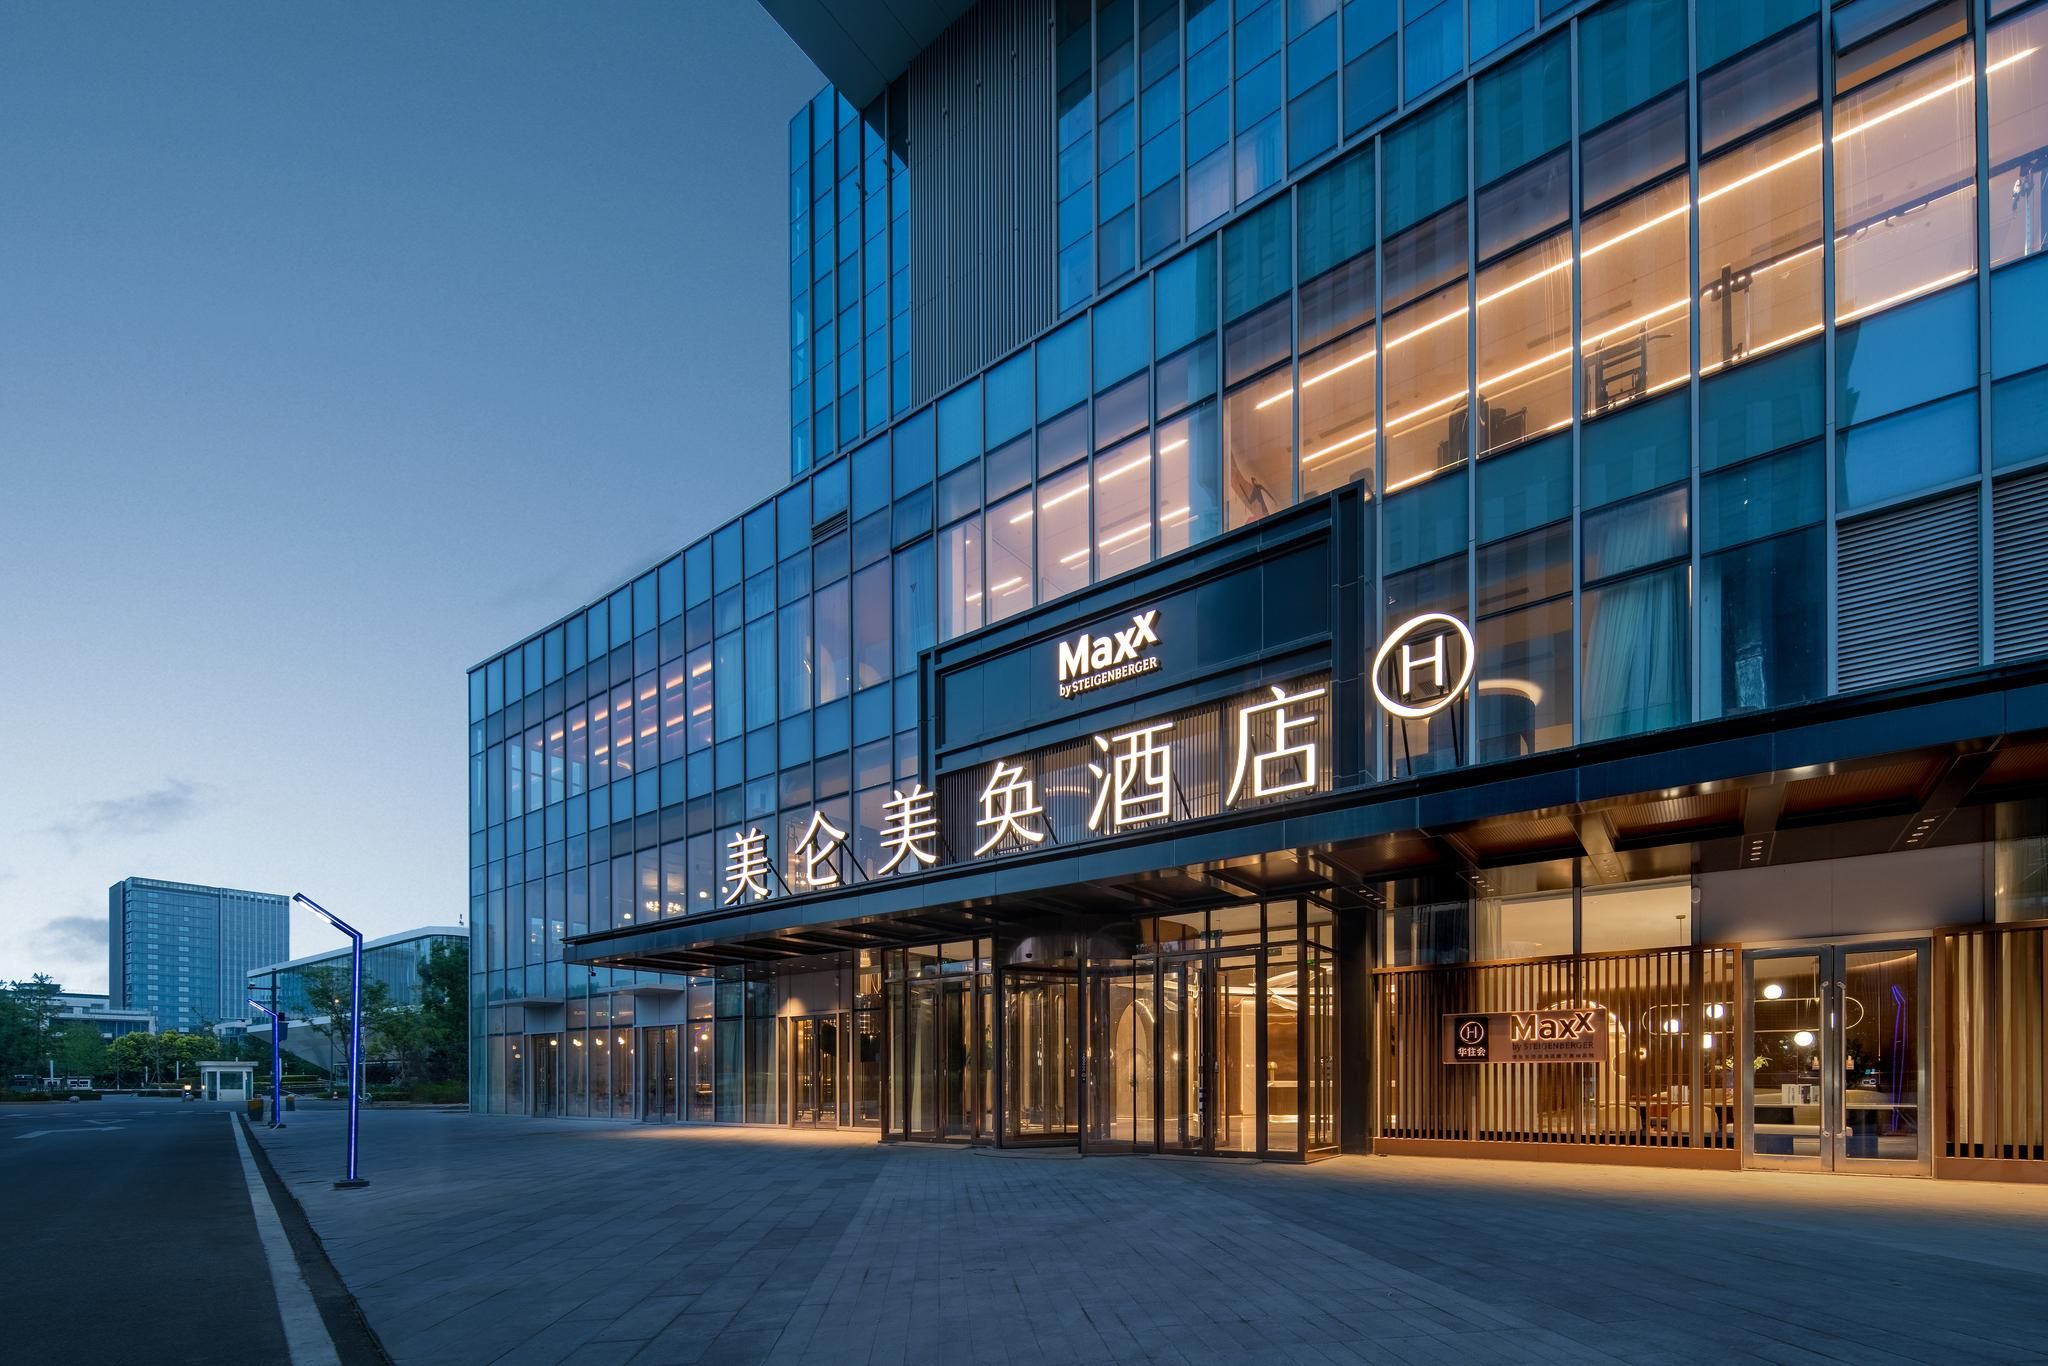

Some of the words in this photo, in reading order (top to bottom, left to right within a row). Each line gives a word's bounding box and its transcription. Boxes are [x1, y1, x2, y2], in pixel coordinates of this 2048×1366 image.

[1059, 610, 1158, 681] Maxx
[1060, 684, 1072, 698] by
[1072, 657, 1158, 693] STEIGENBERGER
[724, 686, 1327, 905] 美仑美奂酒店
[1510, 1011, 1596, 1041] Maxx
[1457, 1047, 1486, 1057] 华住会
[1512, 1042, 1522, 1053] by
[1523, 1041, 1595, 1051] STEIGENBERGER
